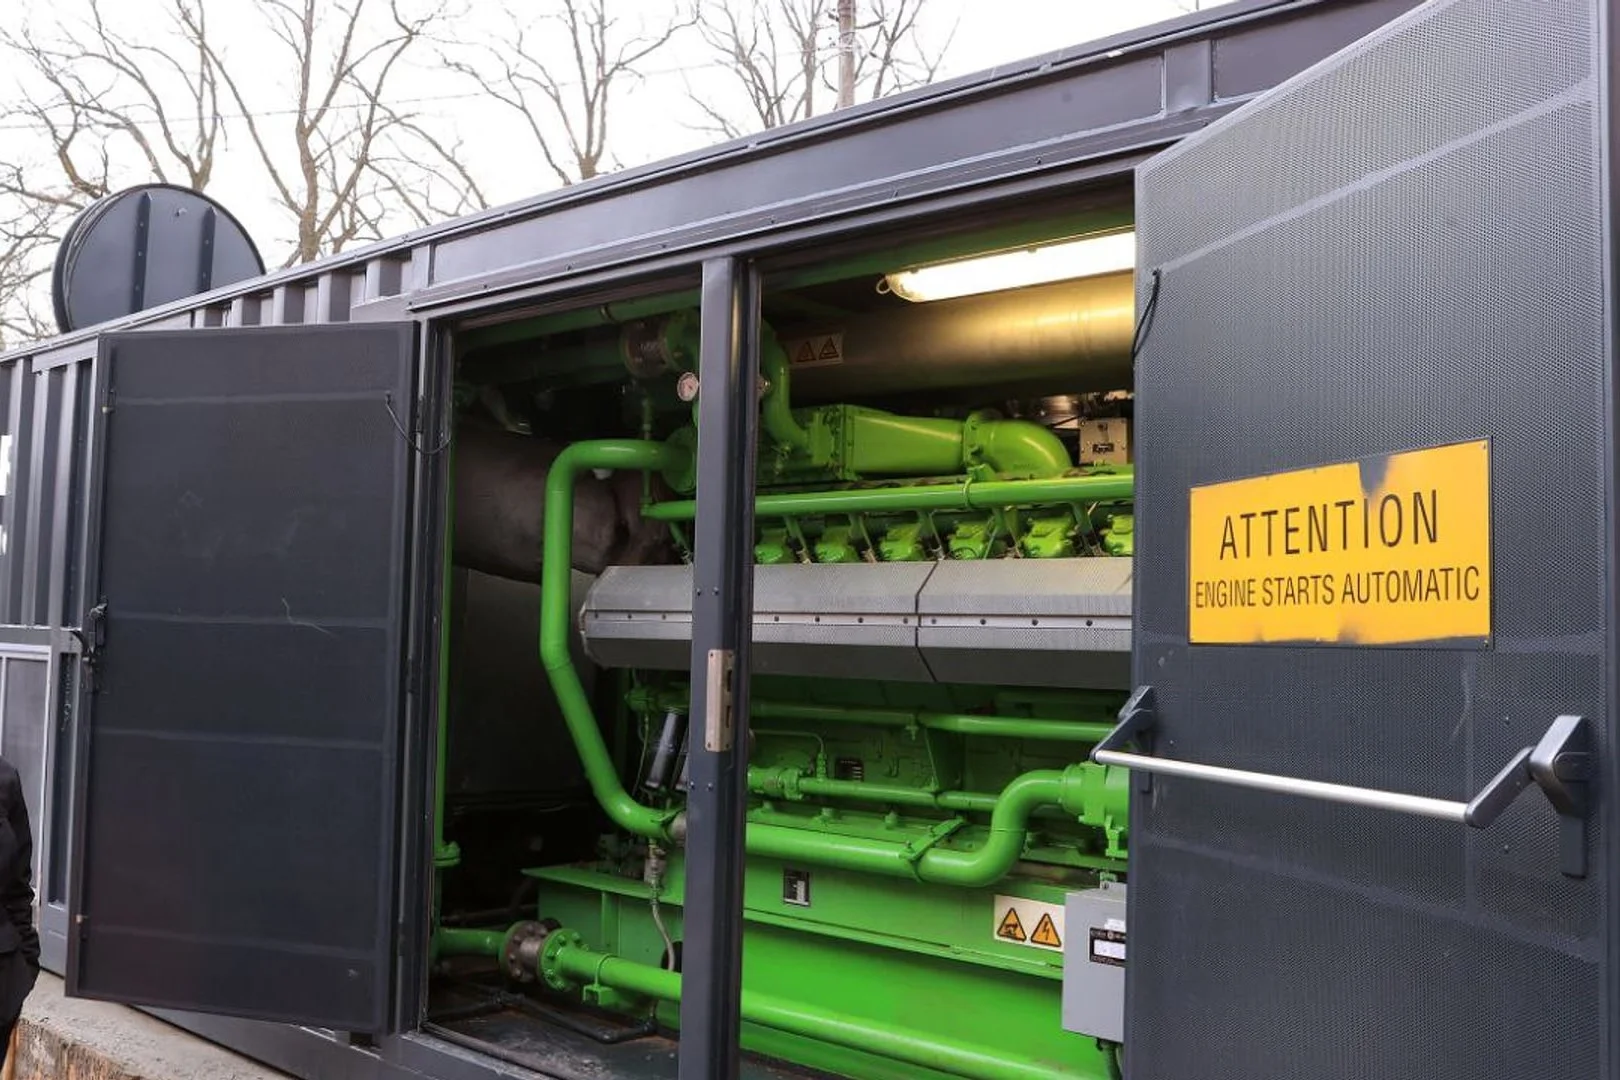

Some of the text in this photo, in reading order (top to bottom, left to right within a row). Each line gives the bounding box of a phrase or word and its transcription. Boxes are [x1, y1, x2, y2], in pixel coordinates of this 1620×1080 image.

[1219, 489, 1438, 560] ATTENTION
[1195, 565, 1480, 608] ENGINE STARTS AUTOMATIC
